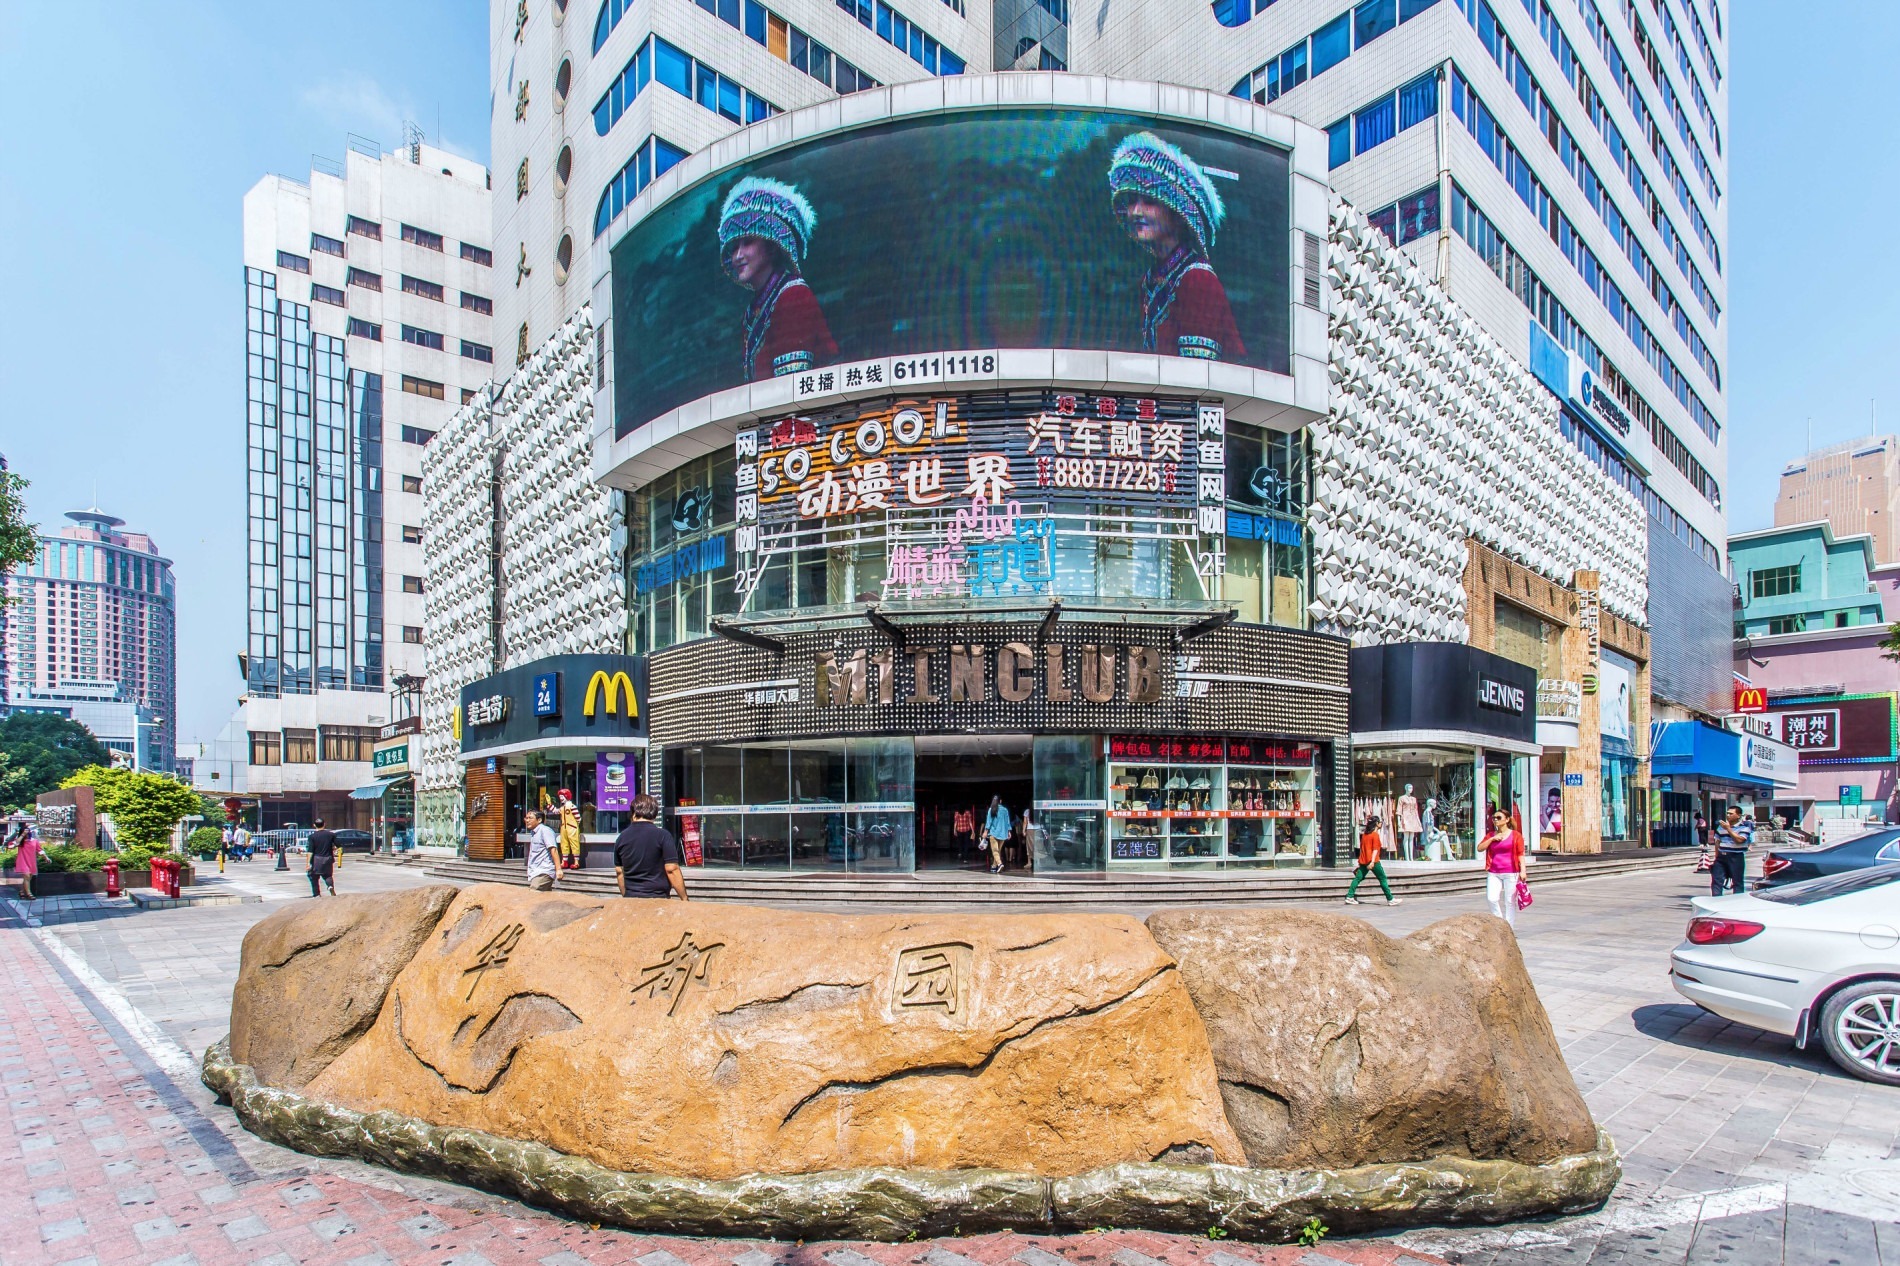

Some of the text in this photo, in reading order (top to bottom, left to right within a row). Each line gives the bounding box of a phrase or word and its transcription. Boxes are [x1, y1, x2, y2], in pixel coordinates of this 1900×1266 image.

[800, 355, 995, 395] 投播 热线 61111118
[760, 400, 961, 497] SO COOL
[1027, 414, 1183, 462] 汽车融资
[1054, 457, 1160, 491] 88877225
[1198, 406, 1226, 534] 网鱼网咖
[735, 430, 758, 553] 网鱼网咖
[797, 456, 1016, 518] 动漫世界
[1199, 552, 1226, 577] 2F
[1174, 656, 1200, 672] 3F
[537, 691, 551, 706] 24
[744, 688, 799, 707] 华都园大厦
[1176, 680, 1209, 698] 酒吧
[468, 695, 503, 726] 麦当劳
[1788, 716, 1827, 732] 潮州
[1789, 731, 1828, 746] 打冷
[1116, 841, 1159, 857] 名牌包
